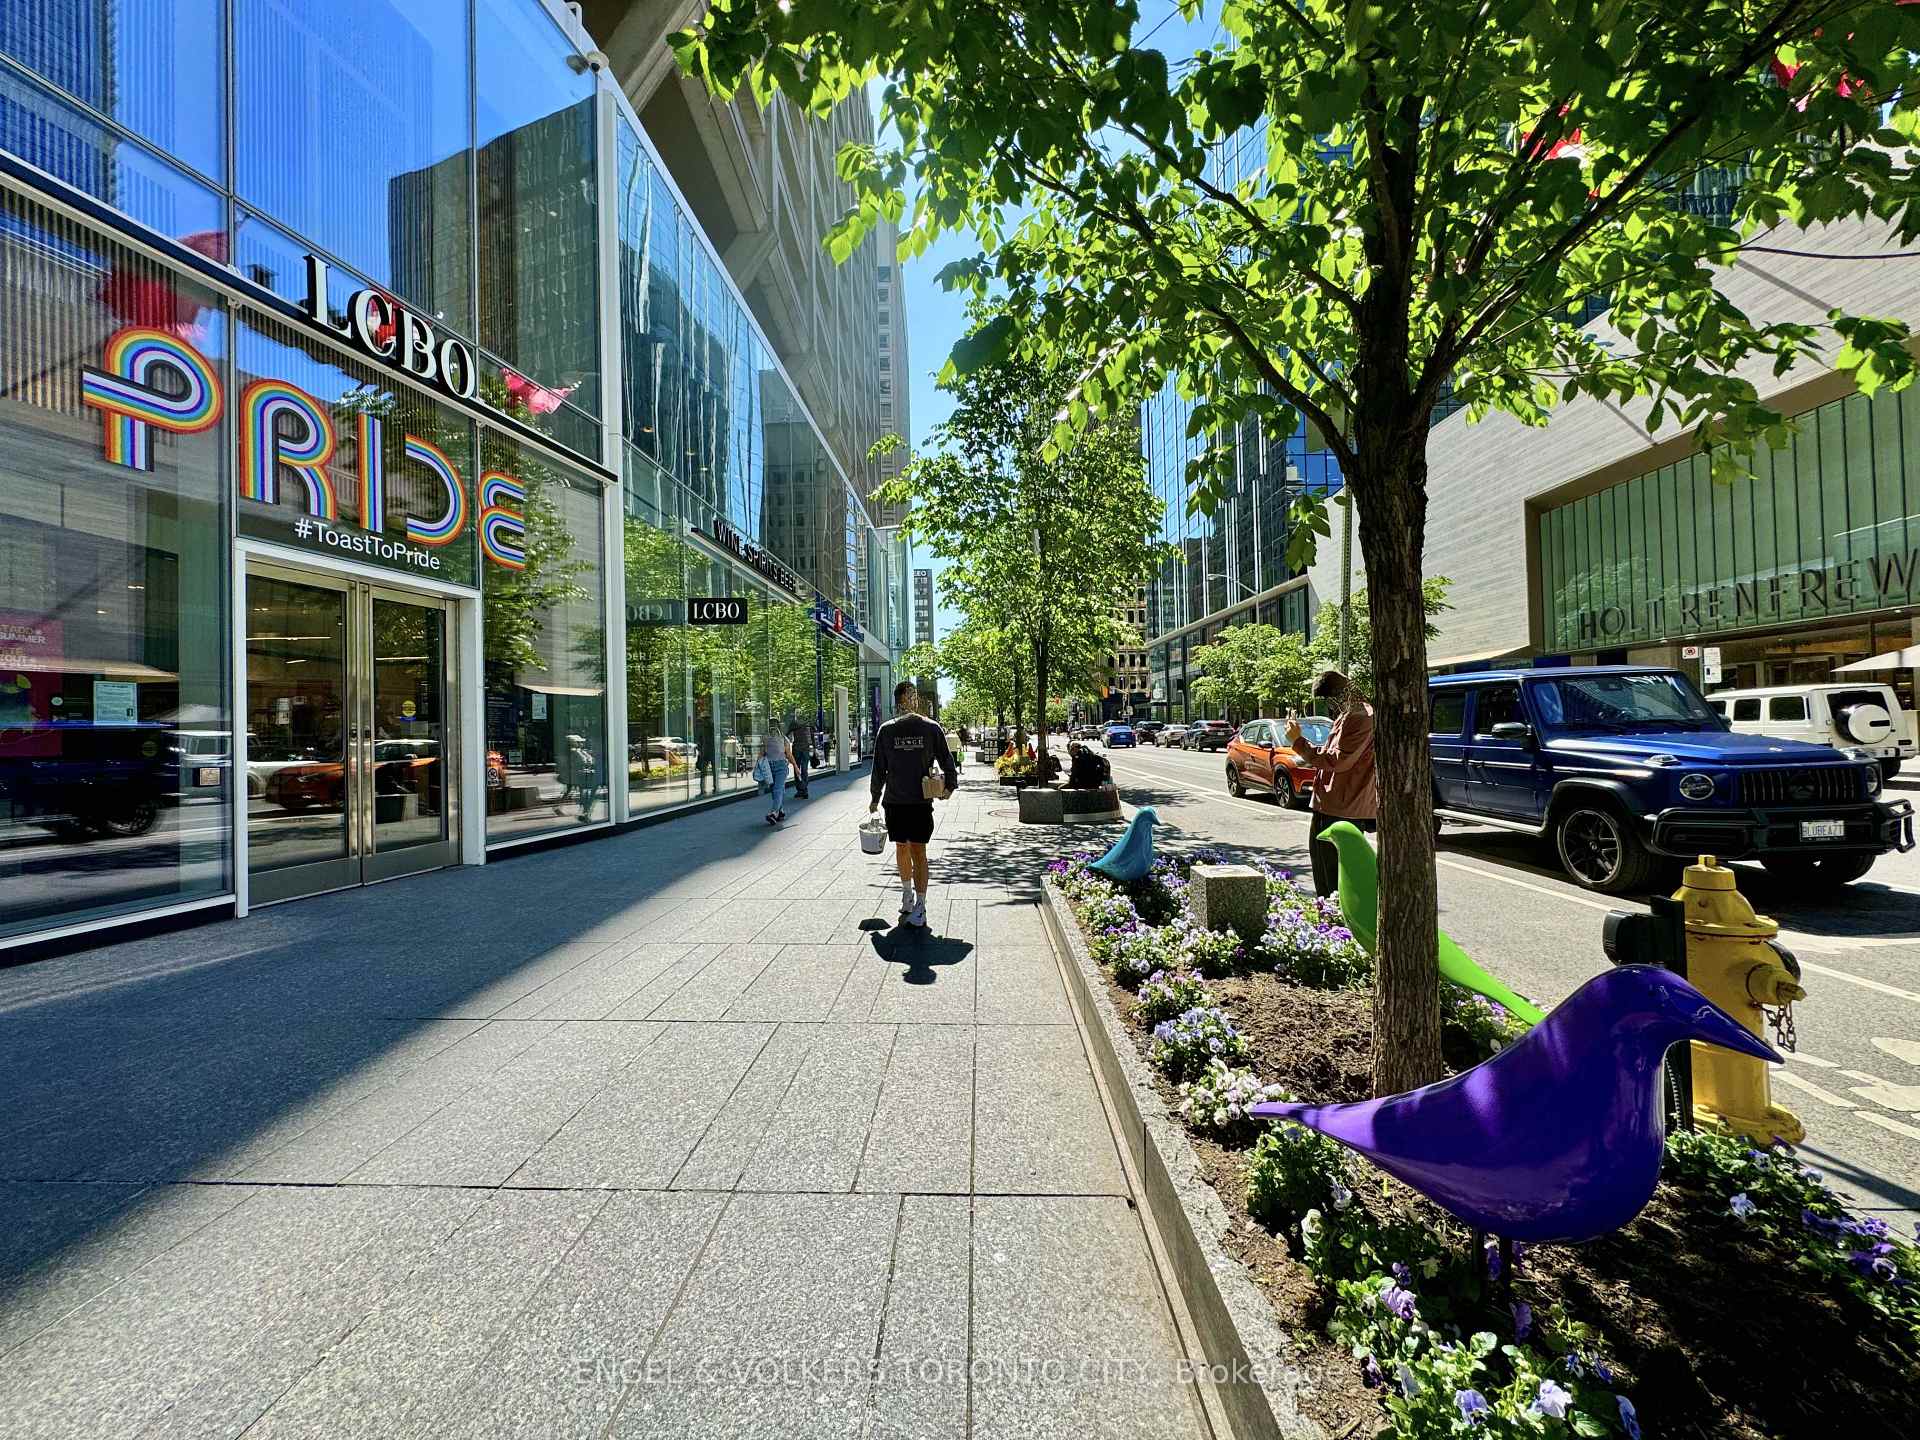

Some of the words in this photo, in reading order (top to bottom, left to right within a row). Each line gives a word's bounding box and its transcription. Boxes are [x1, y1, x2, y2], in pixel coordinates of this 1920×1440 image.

[303, 253, 477, 400] LCBO
[82, 325, 525, 571] PRIDE
[294, 518, 440, 570] #ToastToPride
[693, 602, 740, 620] LCBO
[1580, 598, 1665, 640] HOLT
[1680, 547, 1919, 628] RENFREW
